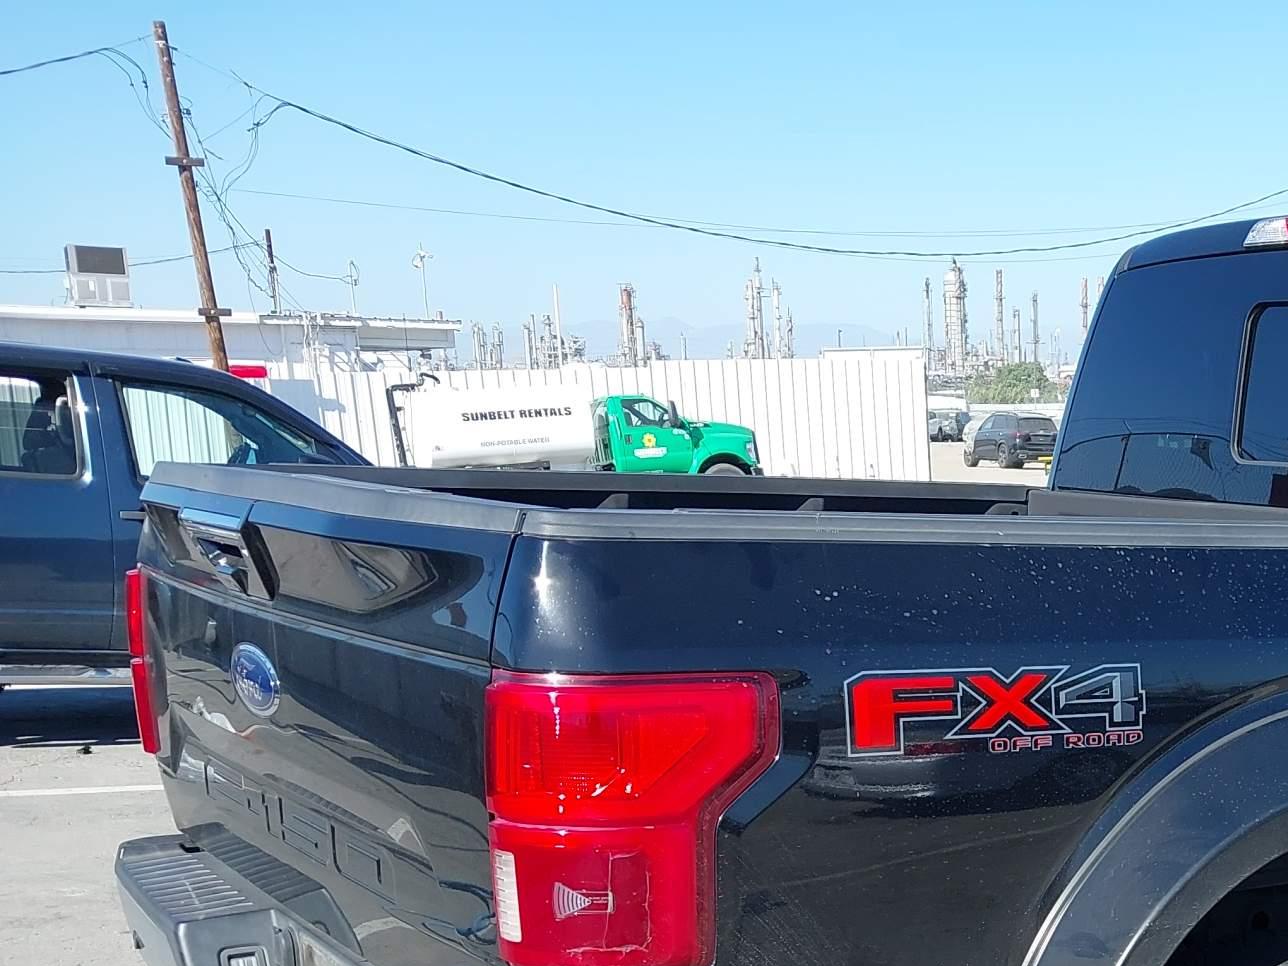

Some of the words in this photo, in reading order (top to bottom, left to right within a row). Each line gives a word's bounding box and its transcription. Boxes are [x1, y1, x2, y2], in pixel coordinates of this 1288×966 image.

[461, 410, 515, 421] SUNBELT
[519, 407, 572, 418] RENTALS
[480, 438, 526, 447] NON-POTABLE
[844, 663, 1147, 757] FX4
[988, 736, 1053, 753] OFF
[1063, 730, 1144, 750] ROAD
[203, 755, 397, 905] F-150
